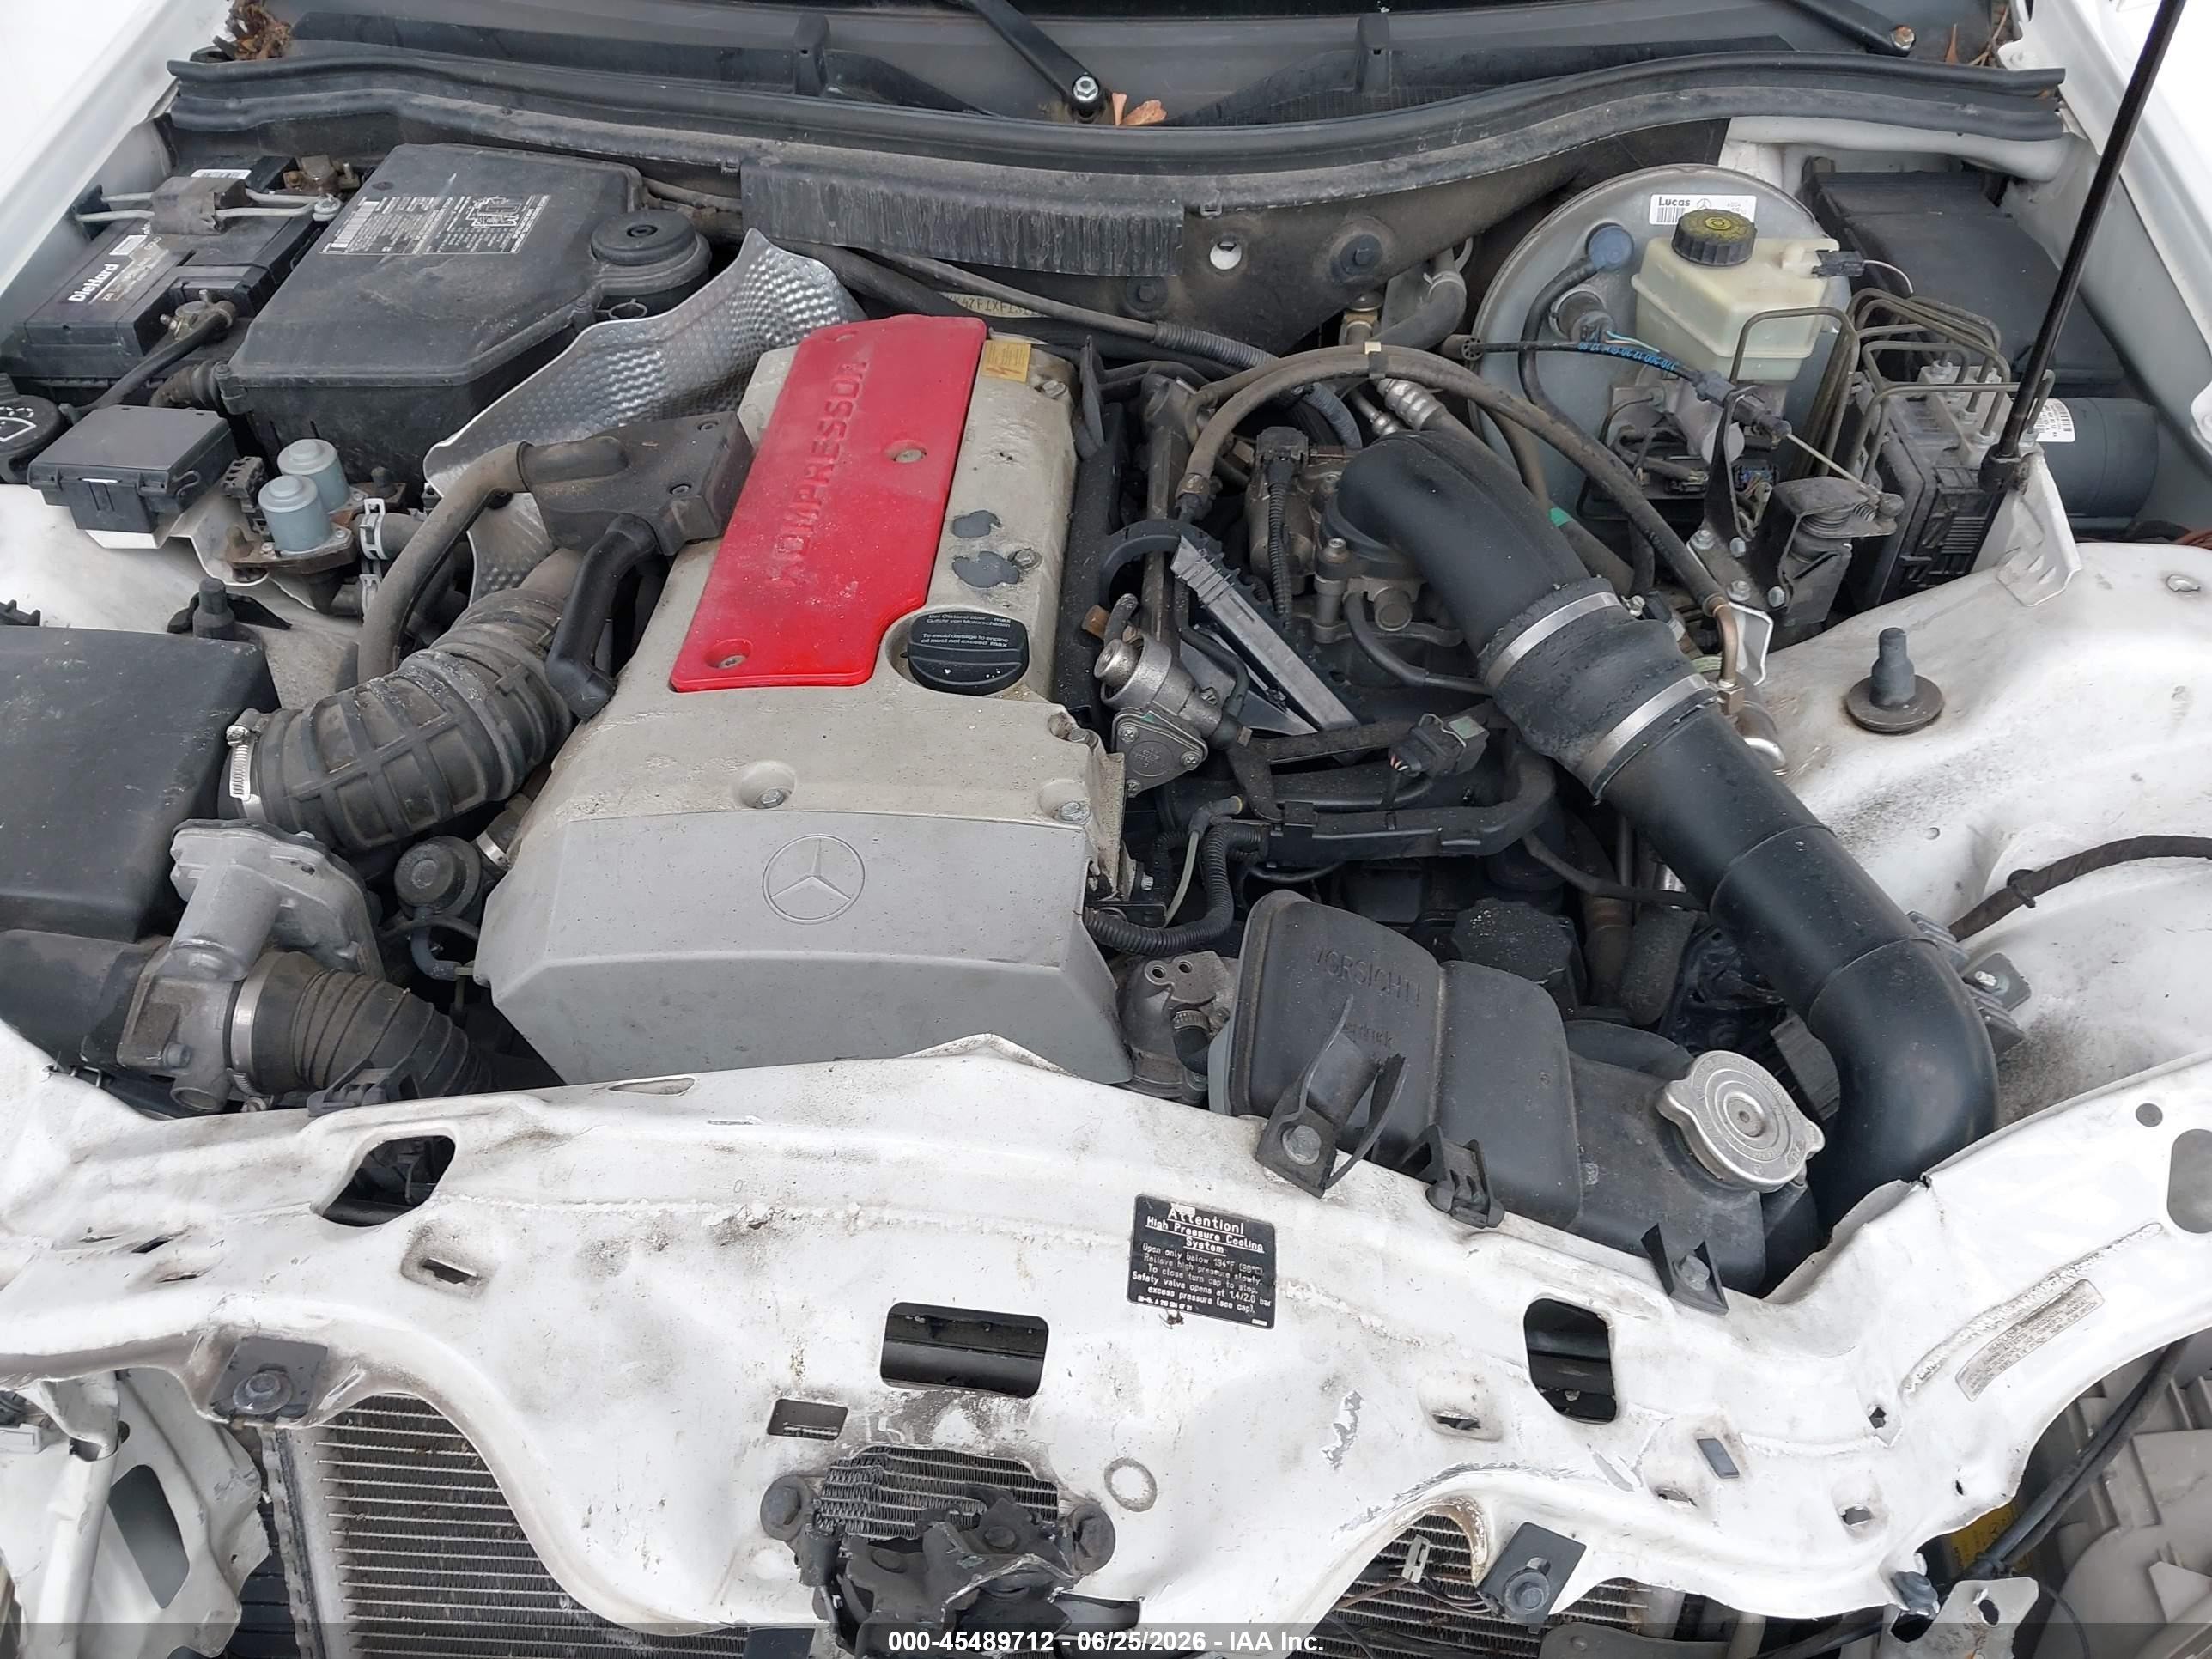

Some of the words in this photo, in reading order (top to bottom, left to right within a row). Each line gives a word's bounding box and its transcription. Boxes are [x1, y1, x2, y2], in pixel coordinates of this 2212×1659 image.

[1659, 197, 1690, 206] Lucas
[68, 264, 119, 301] DieHard
[766, 360, 867, 586] KOMPRESSOR
[1147, 1216, 1168, 1230] High
[1175, 1223, 1220, 1241] Pressure
[1226, 1235, 1263, 1251] Cooling
[1186, 1237, 1224, 1254] System
[1143, 1243, 1161, 1254] Open
[1164, 1249, 1182, 1259] only
[1186, 1252, 1209, 1264] below
[1144, 1254, 1173, 1267] Relieve
[1177, 1259, 1194, 1271] high
[1198, 1266, 1231, 1279] pressure
[1148, 1263, 1158, 1273] To
[1162, 1267, 1183, 1279] close
[1188, 1273, 1204, 1283] turn
[1208, 1277, 1222, 1287] cap
[1226, 1279, 1235, 1289] to
[1132, 1271, 1159, 1285] Safety
[1164, 1278, 1186, 1289] valve
[1189, 1283, 1212, 1294] opens
[1216, 1288, 1224, 1297] at
[1230, 1290, 1256, 1304] 1.4/2.0
[1260, 1297, 1272, 1307] bar
[1147, 1286, 1175, 1297] excess
[1179, 1291, 1212, 1304] pressure
